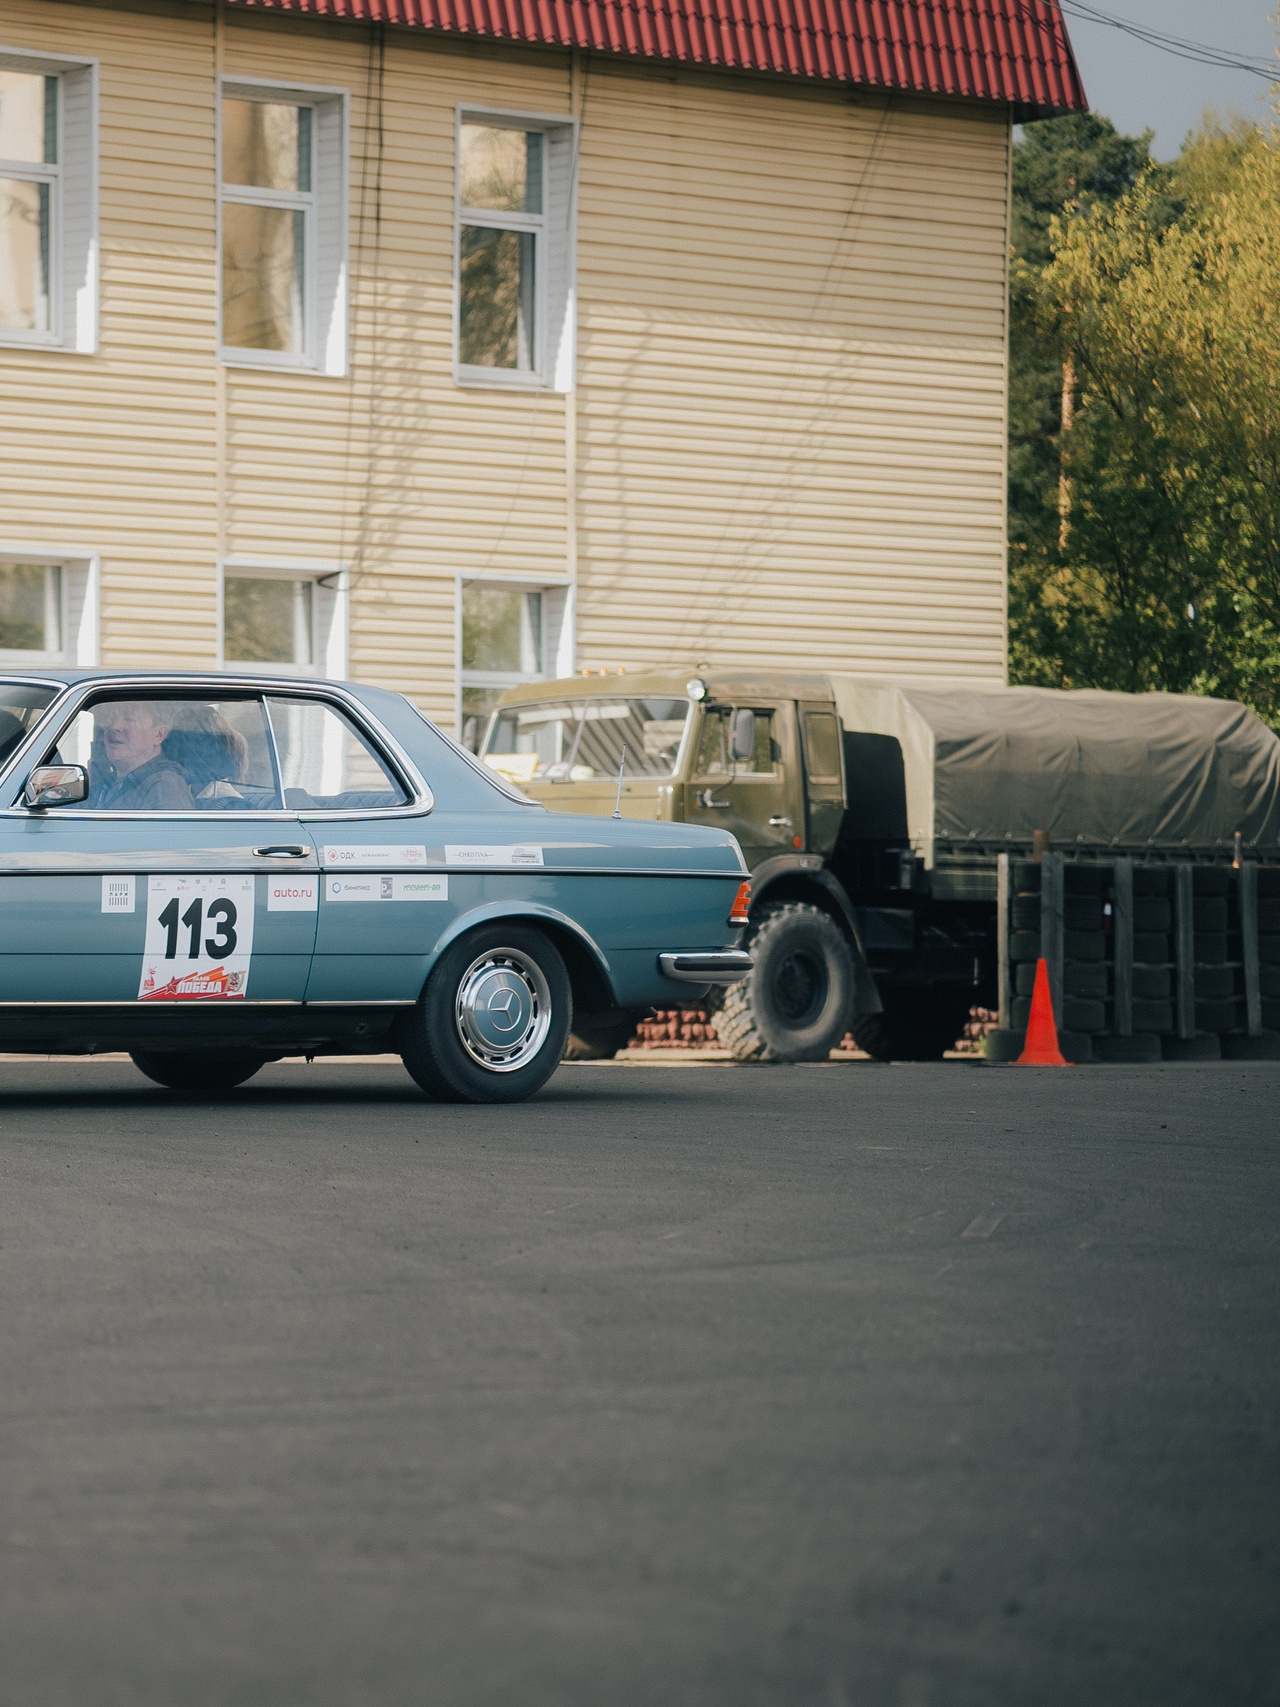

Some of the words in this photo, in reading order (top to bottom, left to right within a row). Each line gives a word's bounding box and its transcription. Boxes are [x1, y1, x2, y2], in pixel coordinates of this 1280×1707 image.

[340, 852, 356, 860] ОДК
[273, 887, 312, 898] auto.ru
[157, 897, 238, 960] 113
[177, 981, 222, 994] ПОБЕДА
